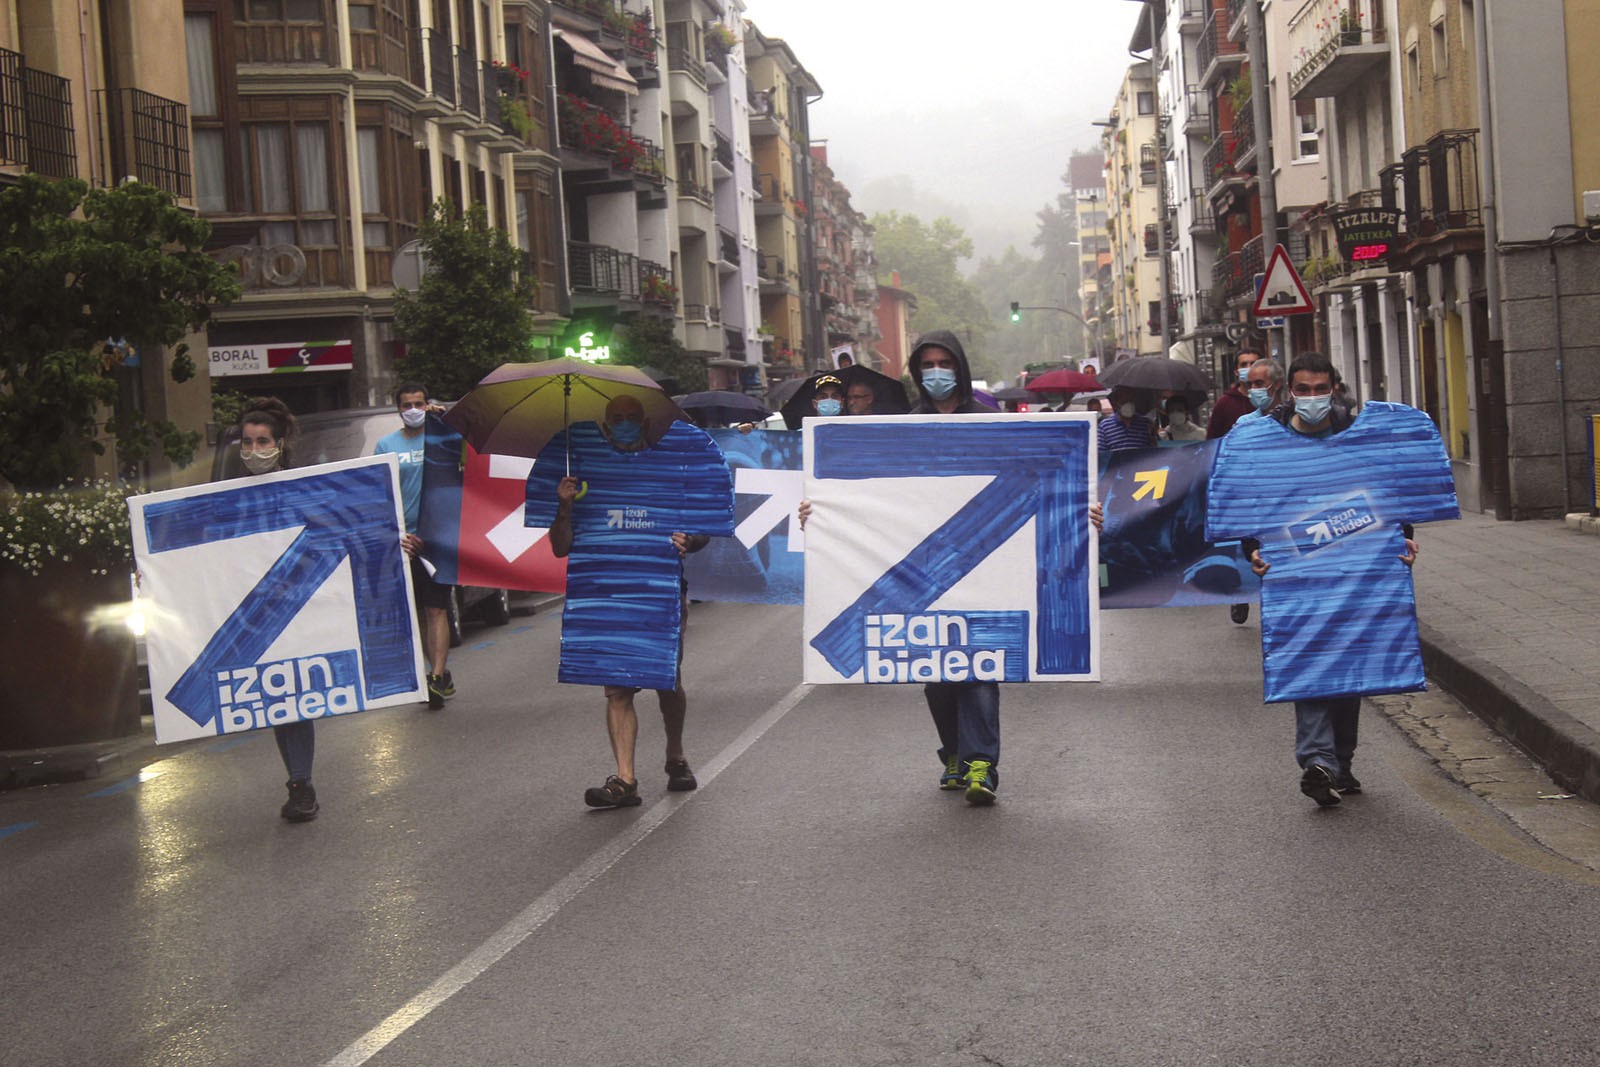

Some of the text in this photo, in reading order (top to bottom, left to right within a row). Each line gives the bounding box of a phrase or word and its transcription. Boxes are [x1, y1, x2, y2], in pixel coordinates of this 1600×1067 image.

[208, 349, 259, 363] BORAL
[626, 506, 648, 518] izan
[1328, 507, 1358, 526] izan
[1332, 514, 1373, 537] bidea
[866, 614, 968, 647] izan
[867, 649, 1005, 683] bidea
[217, 656, 333, 705] izan
[220, 685, 359, 731] bidea
